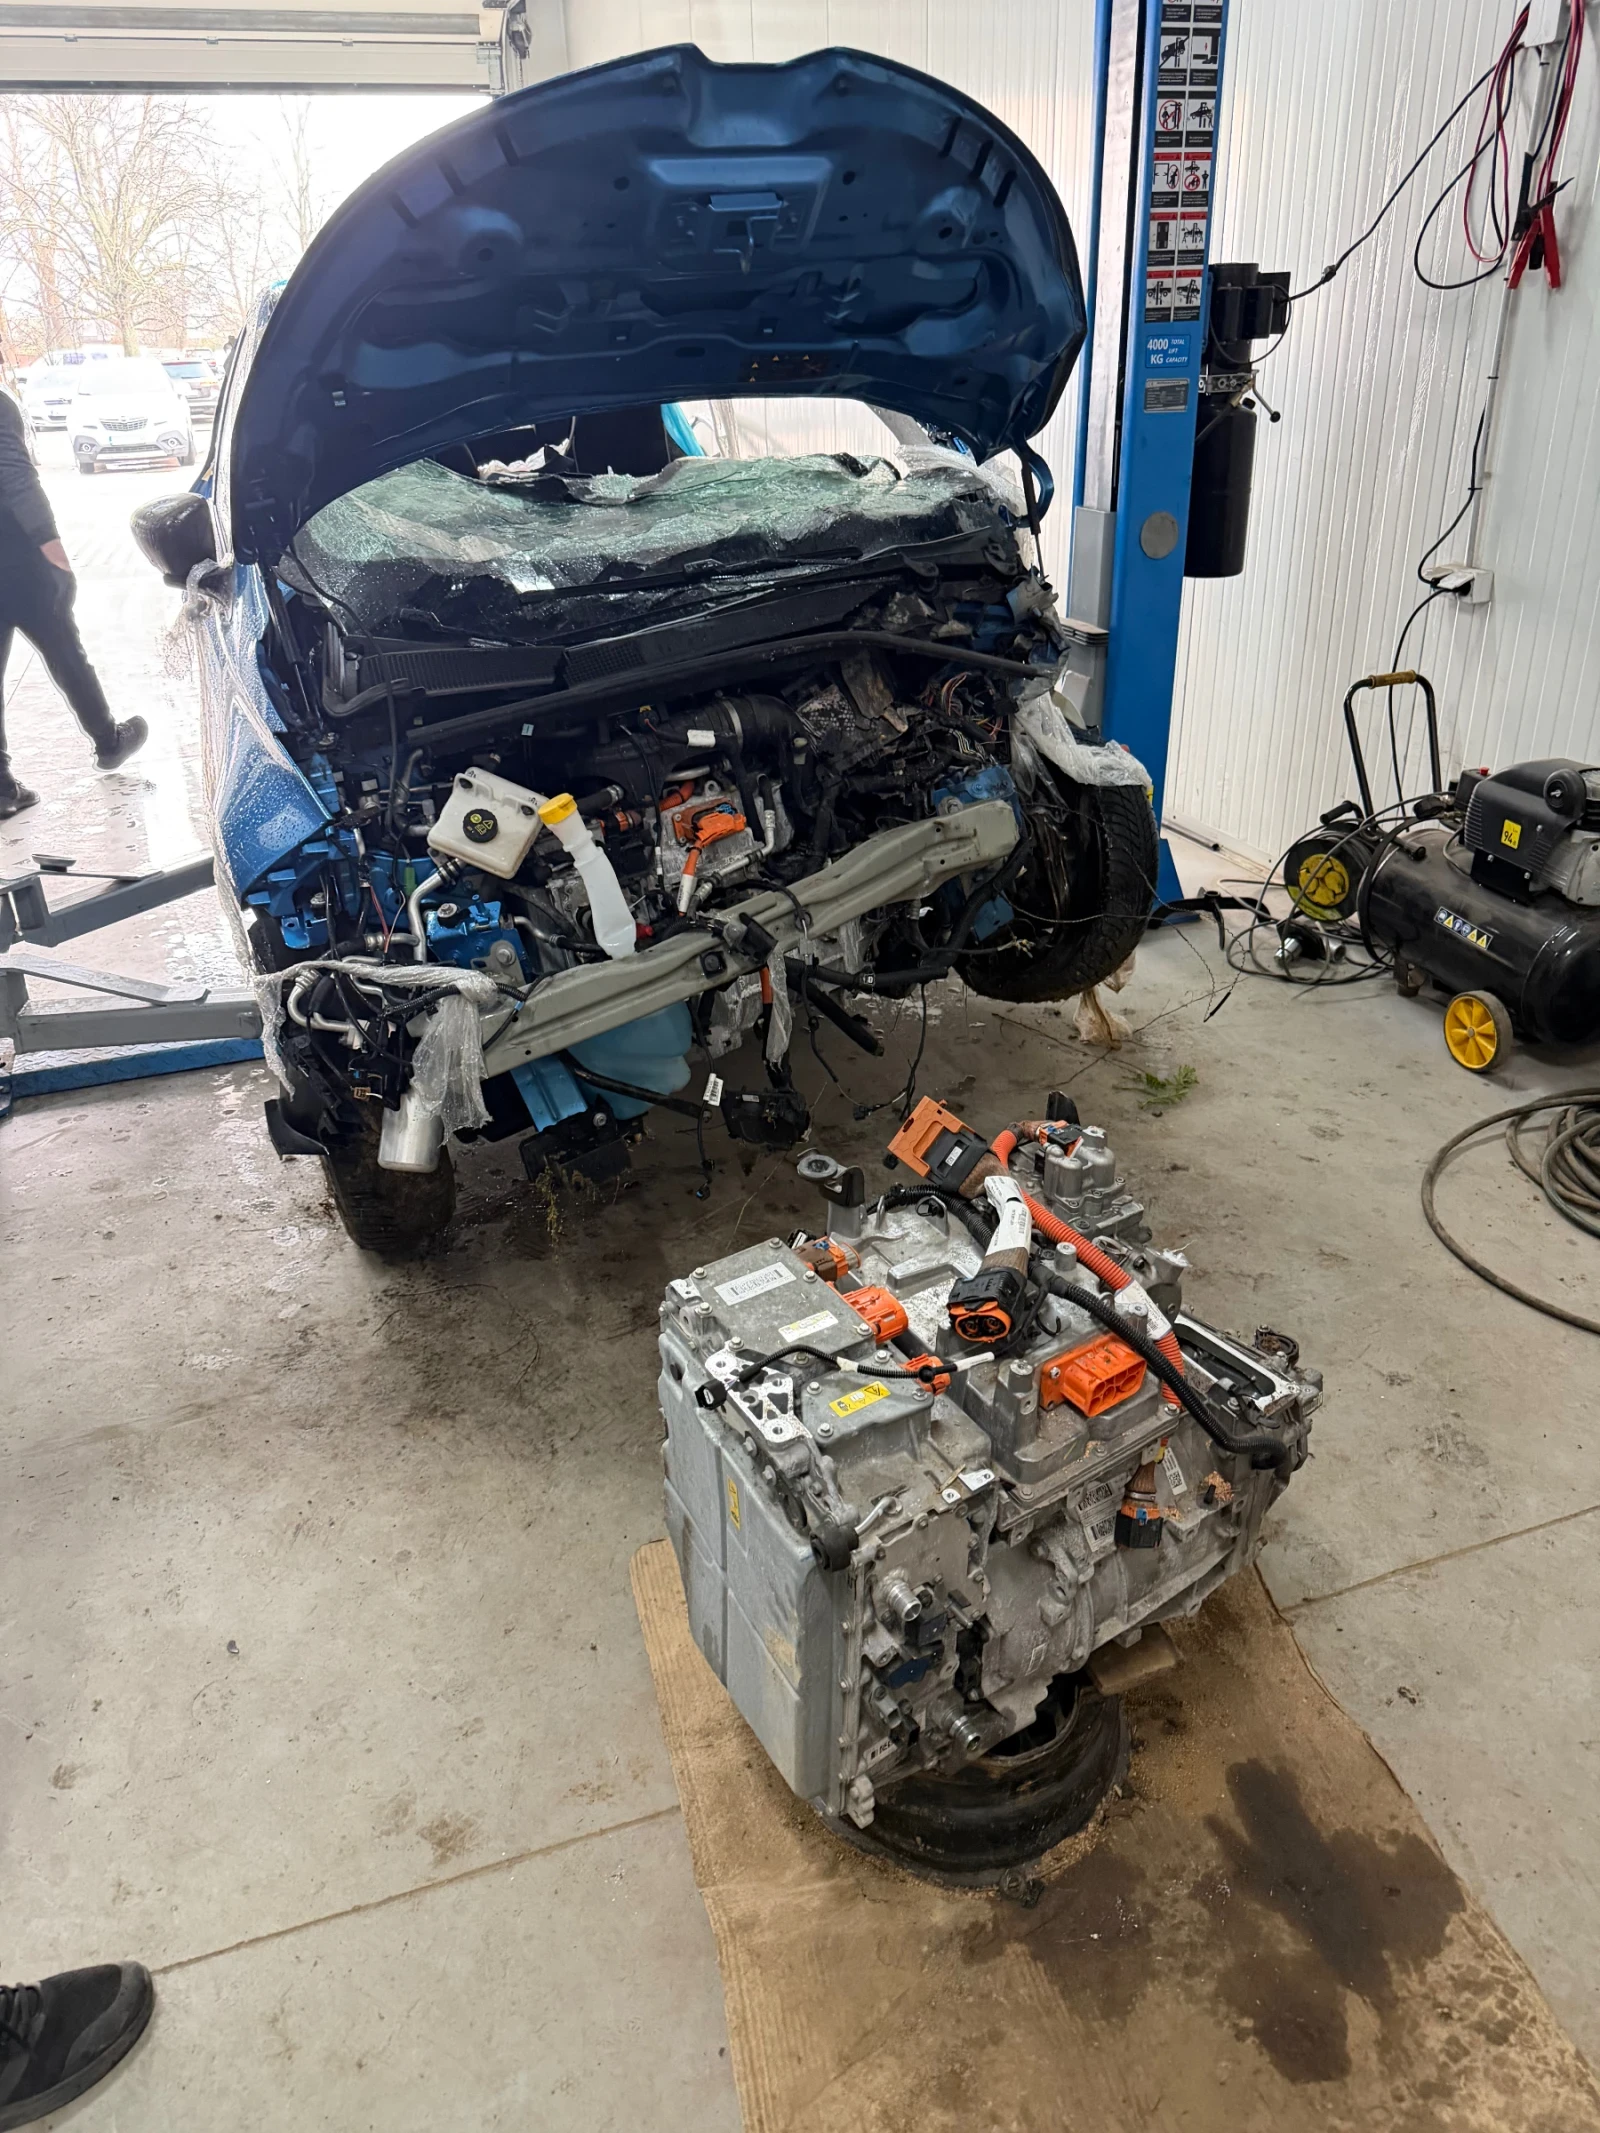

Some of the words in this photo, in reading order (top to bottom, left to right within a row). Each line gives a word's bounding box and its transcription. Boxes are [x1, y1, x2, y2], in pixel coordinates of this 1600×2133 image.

[1147, 338, 1169, 350] 4000
[1150, 354, 1163, 364] KG
[1504, 830, 1513, 844] 94
